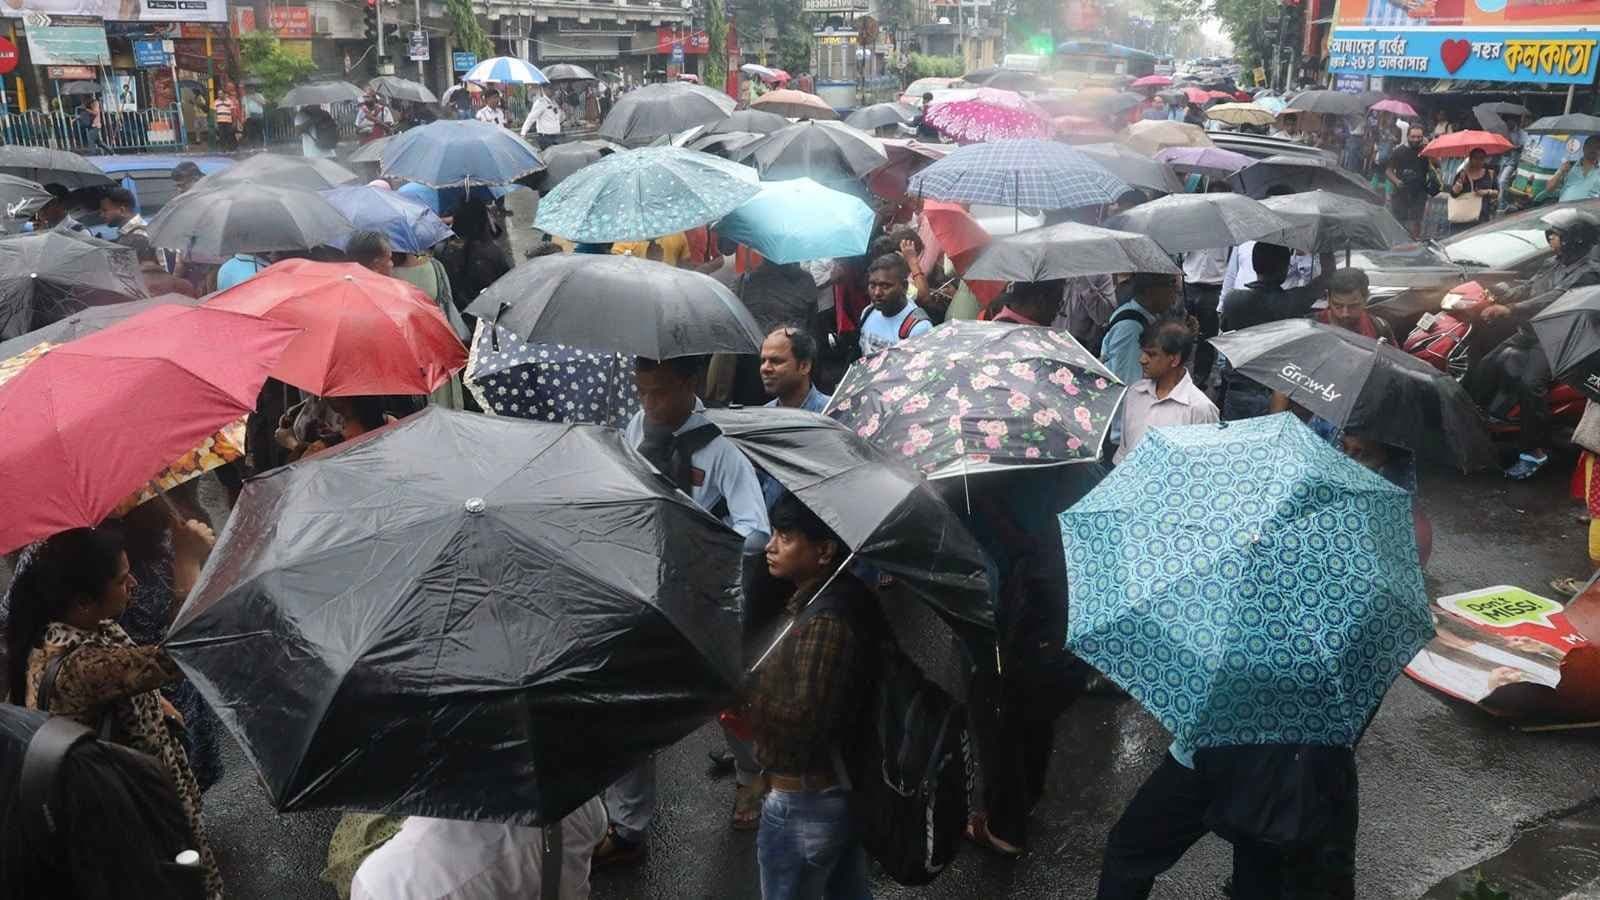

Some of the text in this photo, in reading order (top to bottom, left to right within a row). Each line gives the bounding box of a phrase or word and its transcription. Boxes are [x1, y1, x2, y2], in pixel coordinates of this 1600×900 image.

[1471, 39, 1597, 75] শহর কলকাতা
[1481, 600, 1543, 621] MISS!
